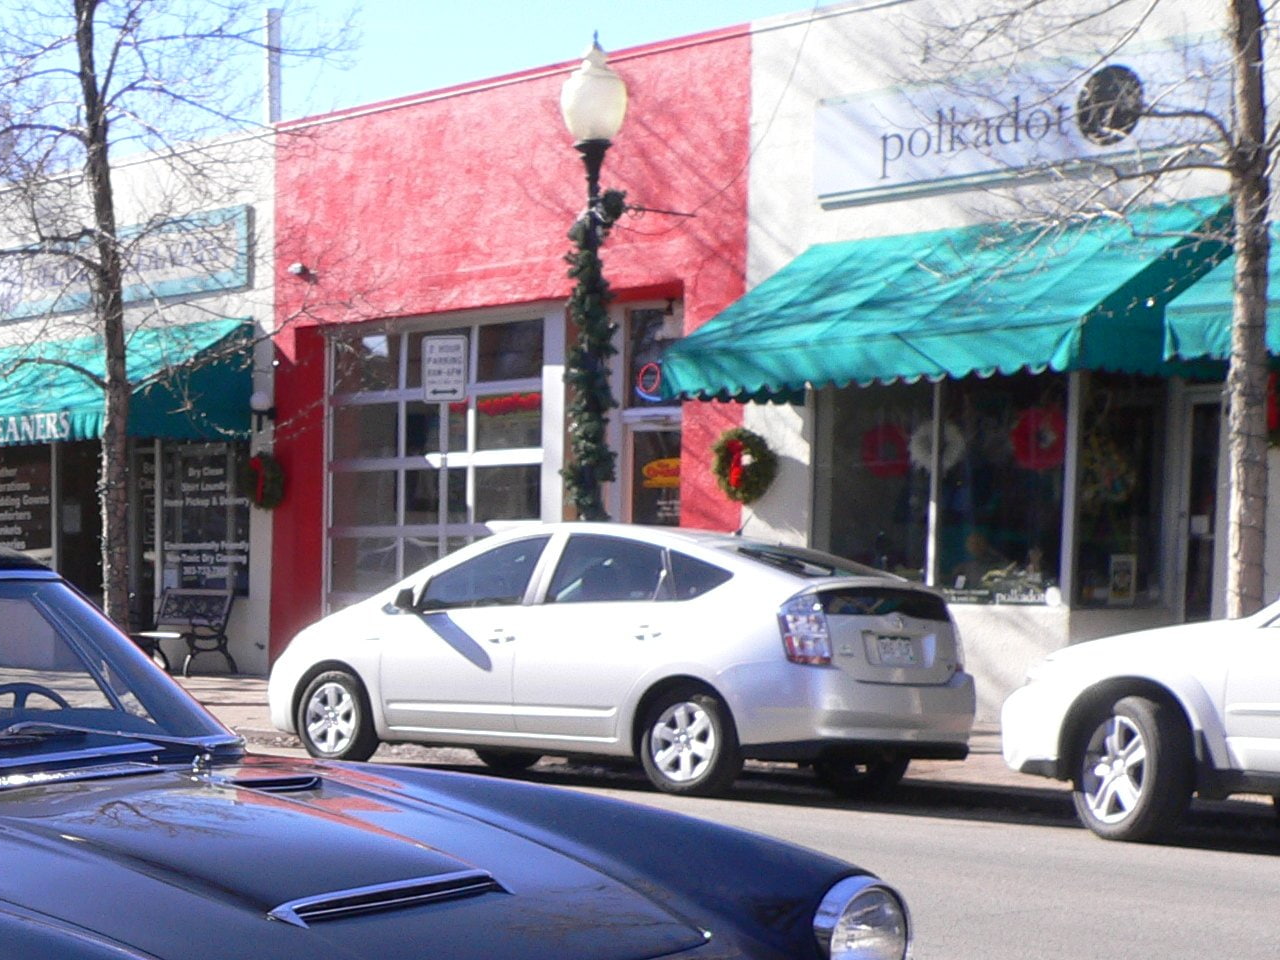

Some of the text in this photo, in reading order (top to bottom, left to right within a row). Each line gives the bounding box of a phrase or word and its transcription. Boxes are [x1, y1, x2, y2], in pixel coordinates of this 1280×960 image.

[880, 95, 1070, 179] polkadot
[427, 355, 462, 365] PARKING
[22, 494, 49, 505] Gowns
